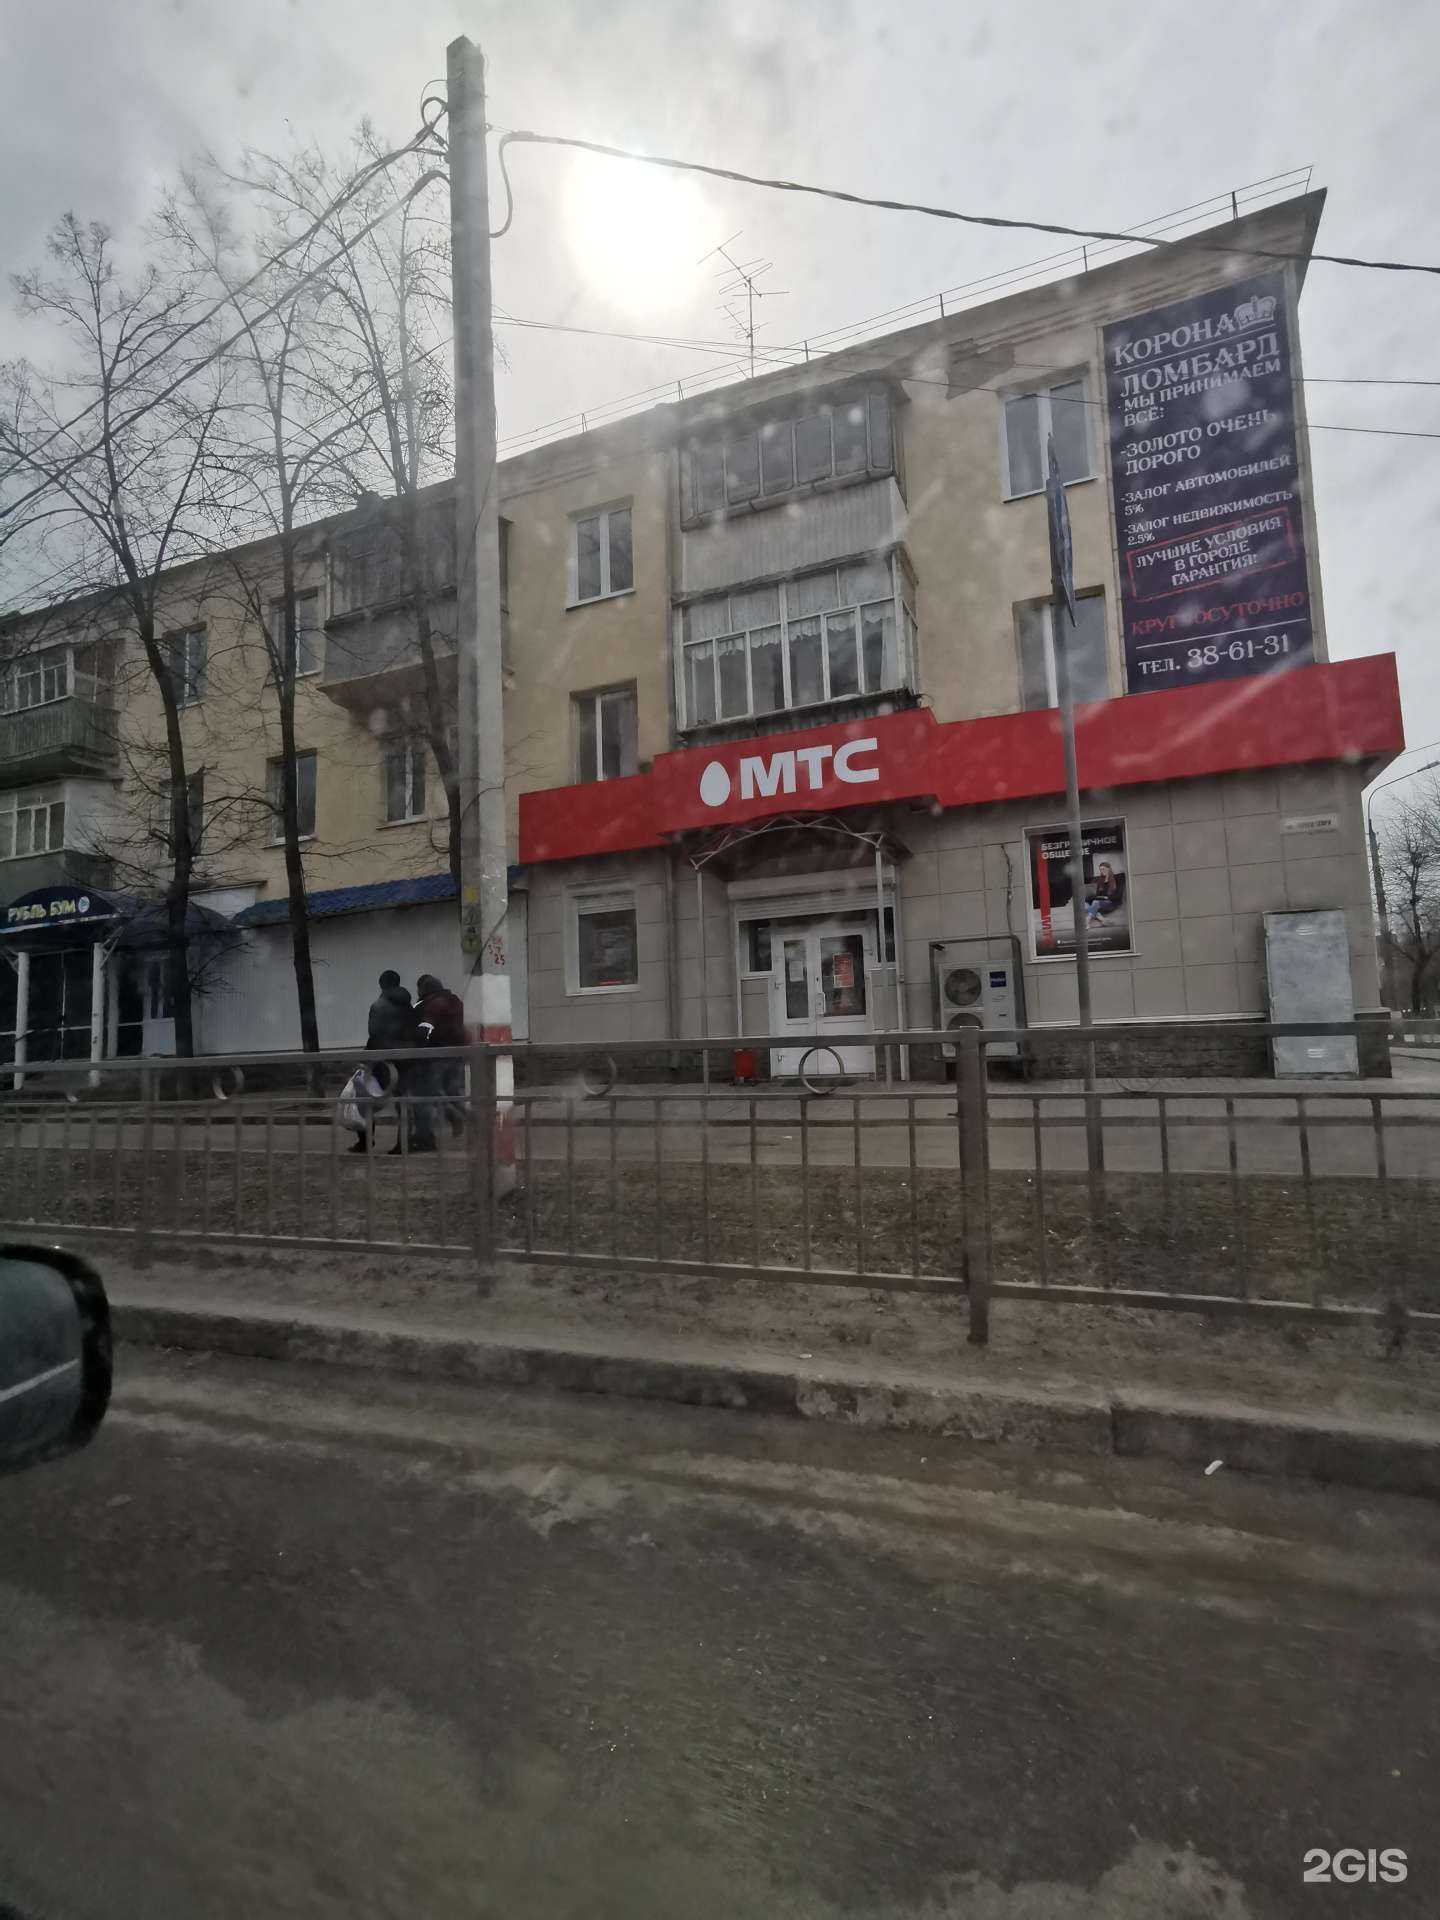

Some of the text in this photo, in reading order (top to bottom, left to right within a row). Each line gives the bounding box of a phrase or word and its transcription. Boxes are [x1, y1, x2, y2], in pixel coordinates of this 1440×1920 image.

[1114, 313, 1236, 366] КОРОНА
[1120, 332, 1281, 397] ЛОМБАРД
[1123, 358, 1281, 412] МЫ ПРИНИМАЕМ
[1120, 409, 1278, 457] -ЗОЛОТО ОЧЕНЬ
[1125, 445, 1201, 476] ДОРОГО
[1124, 504, 1144, 516] 5%
[1136, 517, 1281, 568] ЛУЧШИЕ УСЛОВИЯ
[1175, 540, 1250, 571] В ГОРОДЕ
[1138, 632, 1290, 675] ТЕЛ. 38-61-31
[739, 737, 880, 800] МТС
[1041, 836, 1117, 851] БЕЗГРИЧНОЕ
[1041, 848, 1090, 860] ОБЩЕЕ
